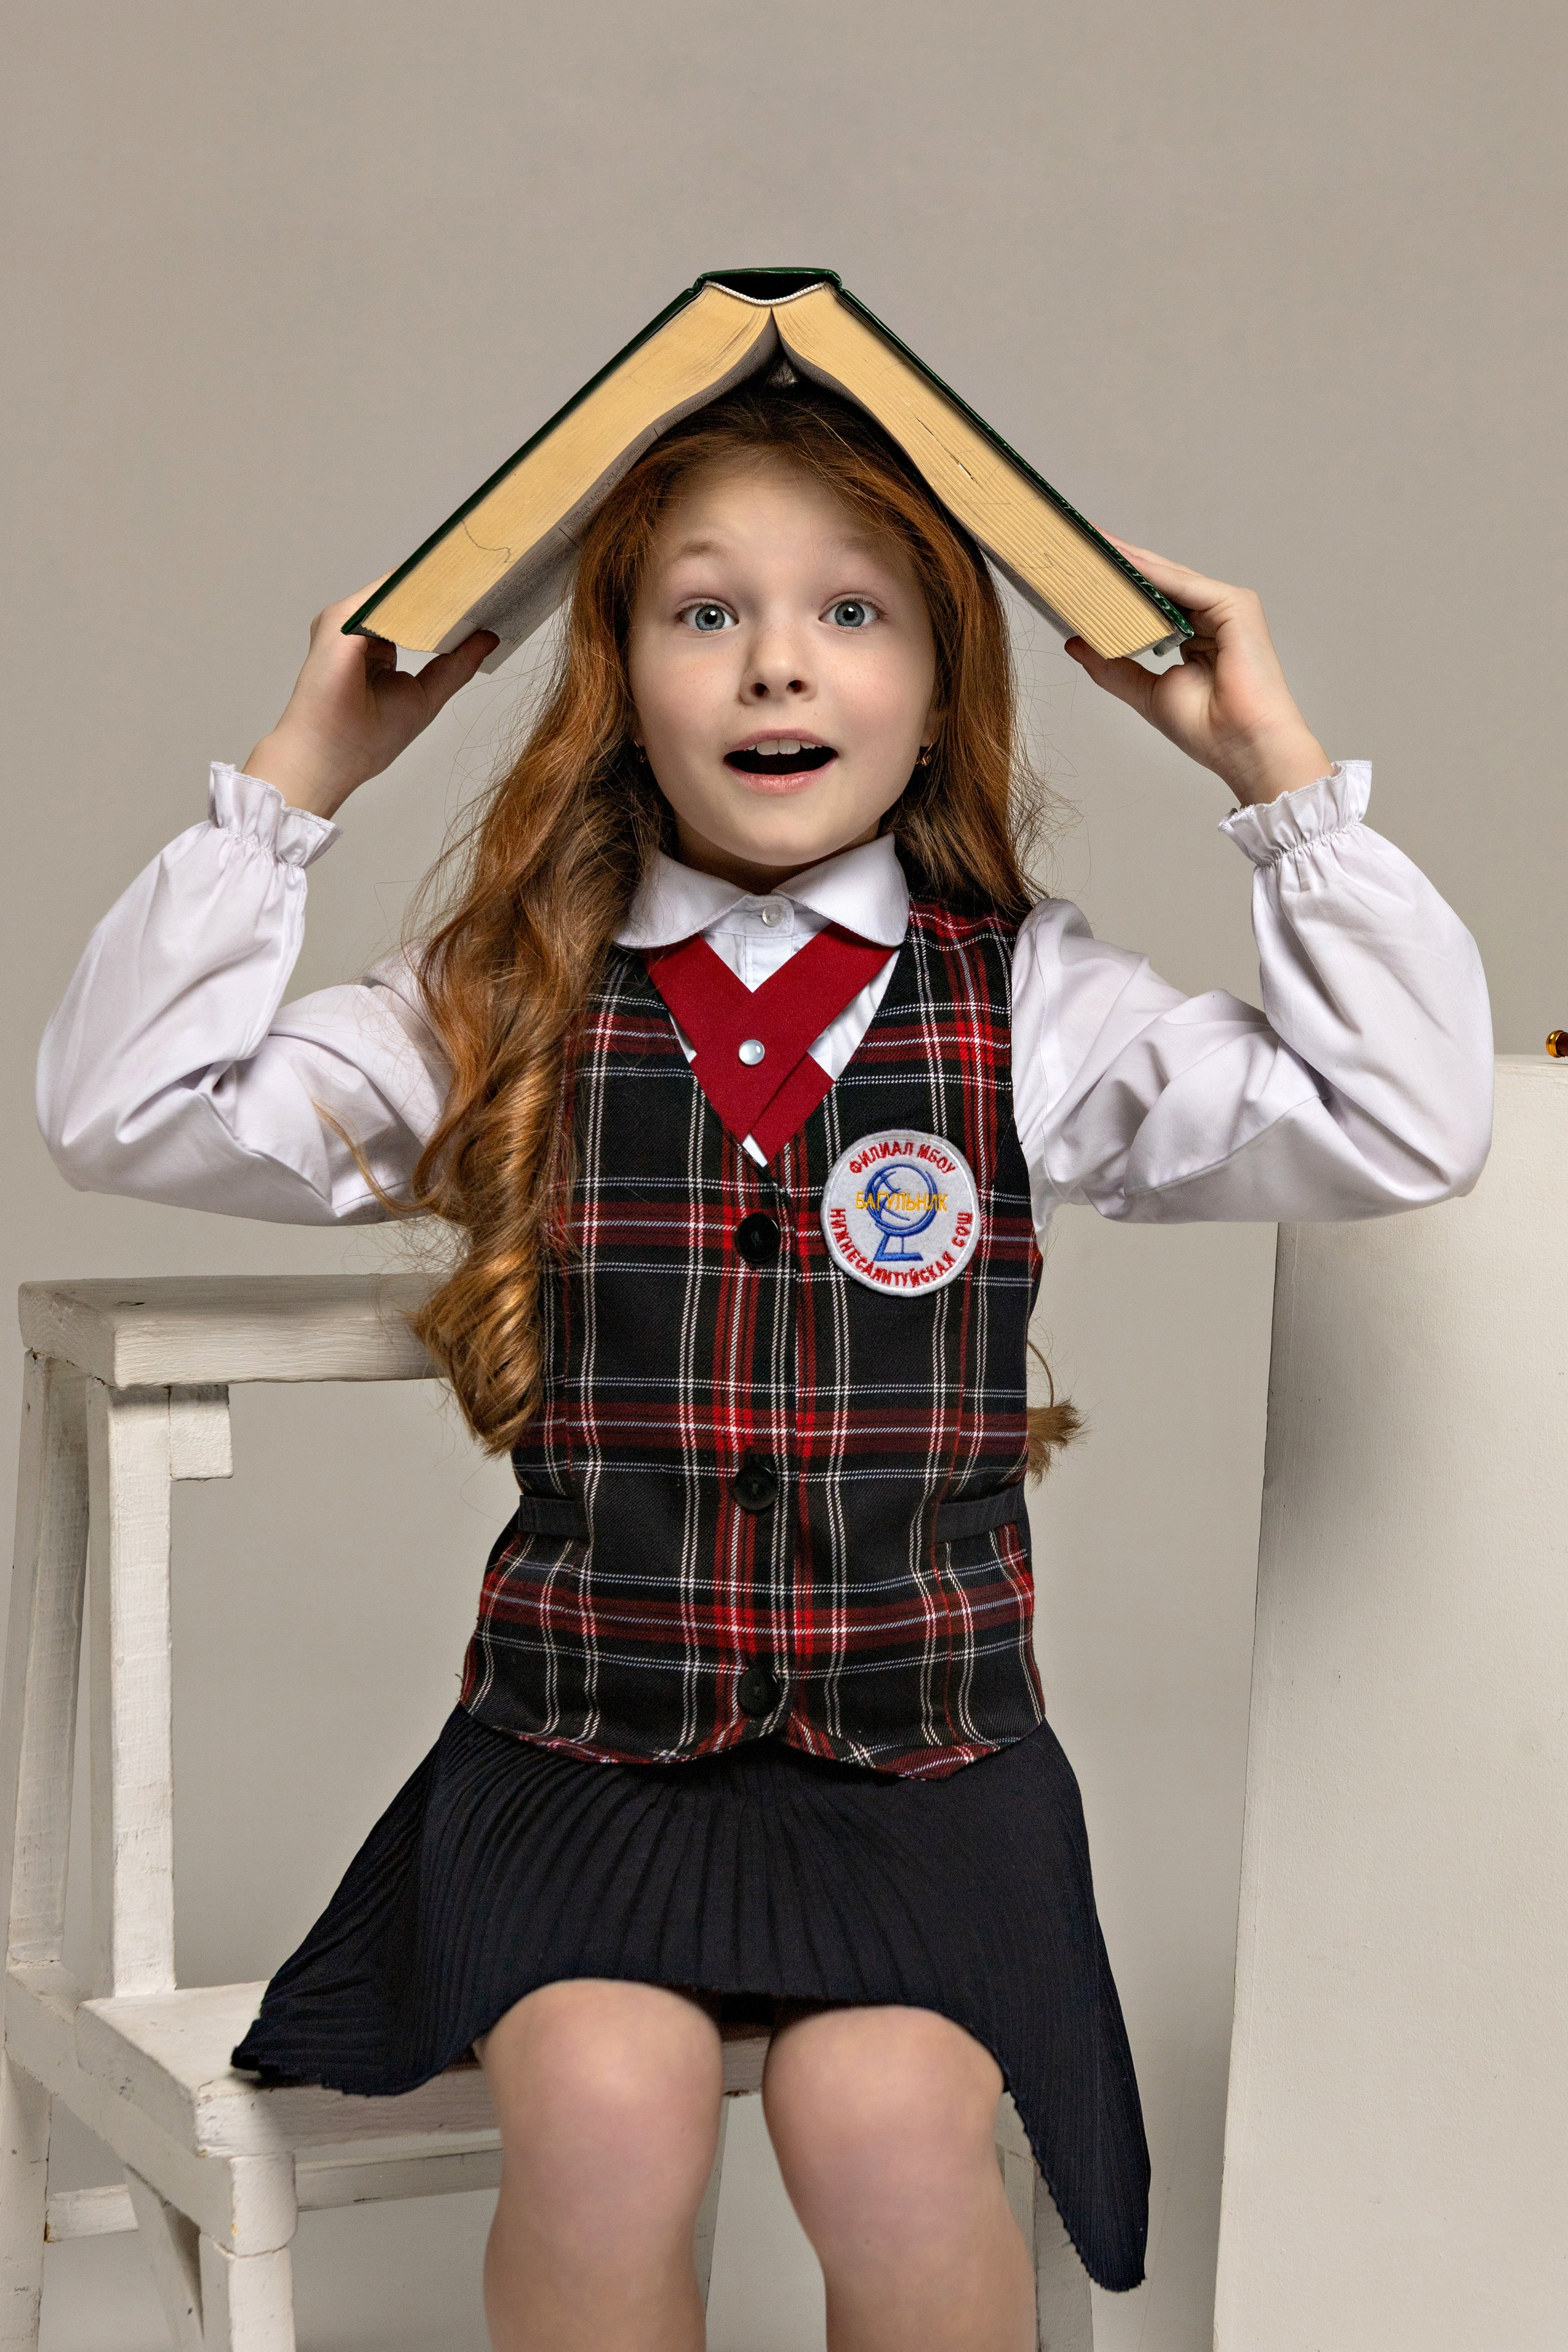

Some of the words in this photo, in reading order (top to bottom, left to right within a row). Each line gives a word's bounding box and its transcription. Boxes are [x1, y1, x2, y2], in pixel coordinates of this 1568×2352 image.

[849, 1141, 914, 1173] ФИЛИАЛ
[917, 1144, 956, 1174] МБОУ
[855, 1191, 948, 1211] БАГУЛЬНИК
[951, 1212, 973, 1248] СОШ
